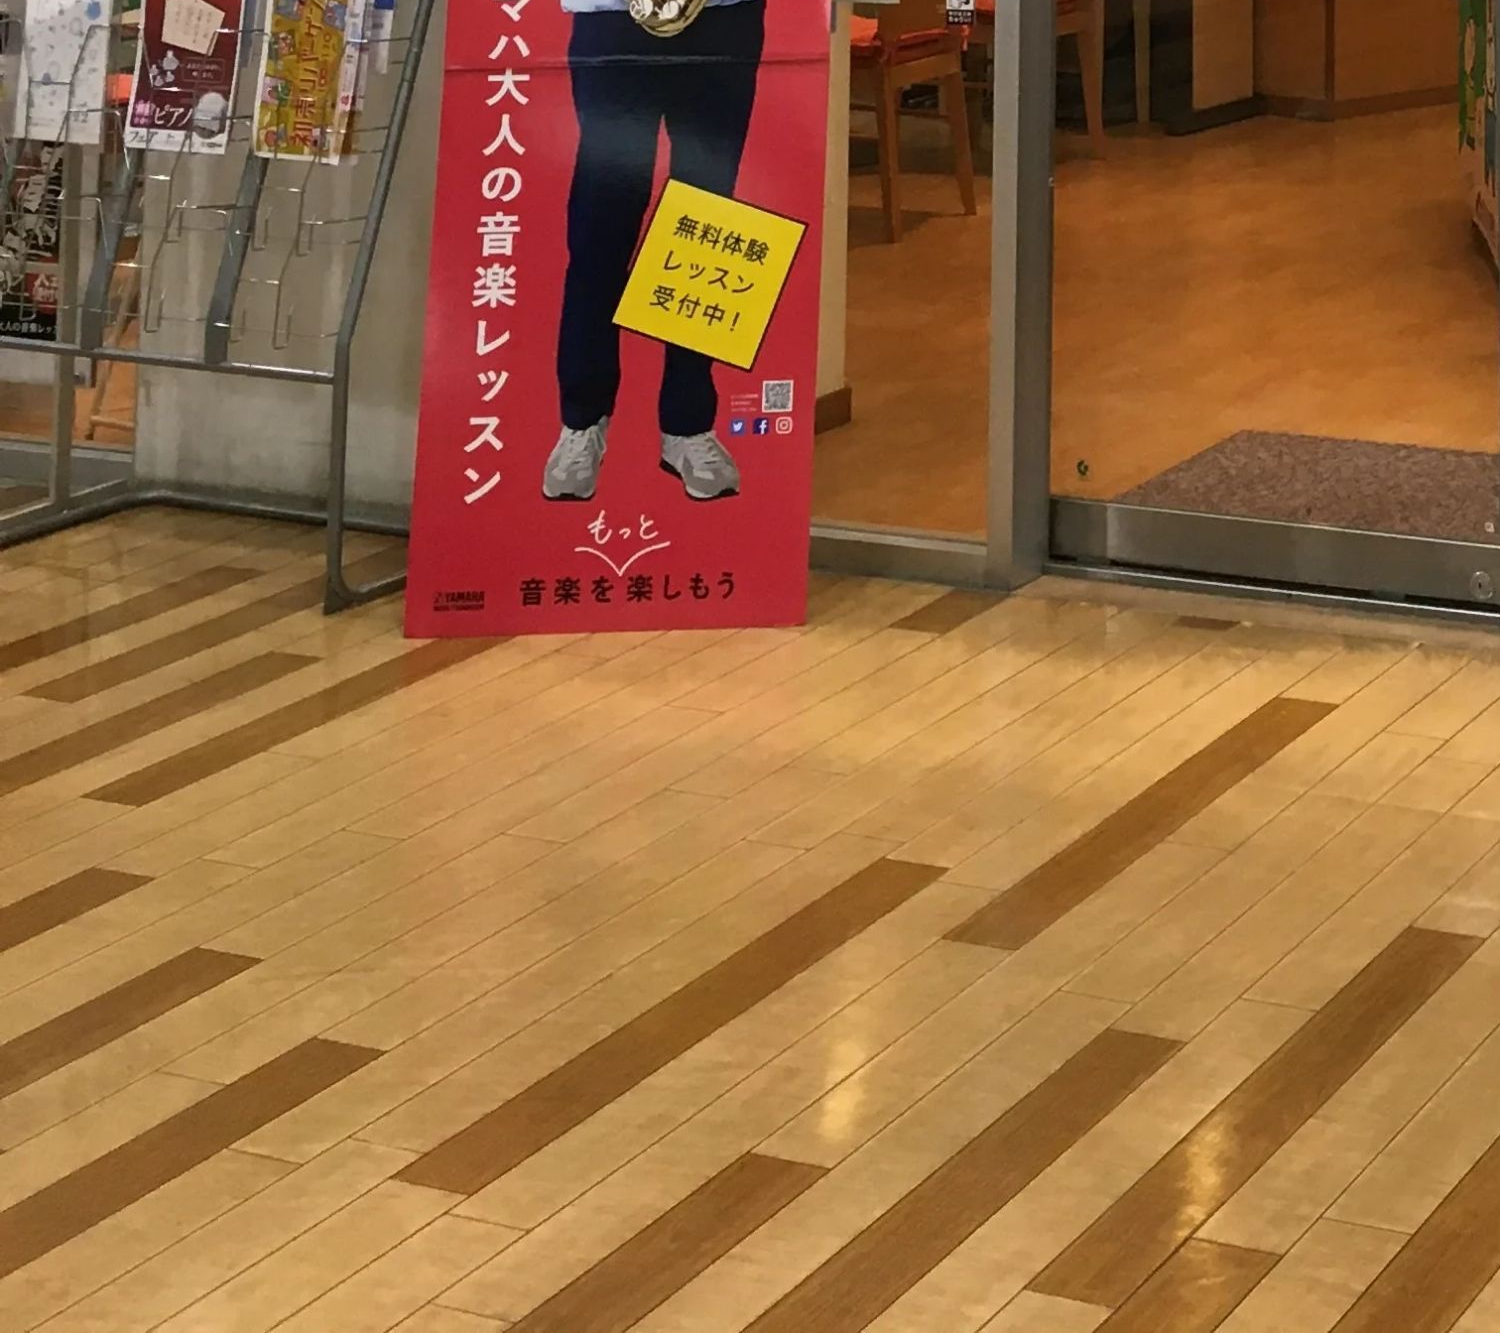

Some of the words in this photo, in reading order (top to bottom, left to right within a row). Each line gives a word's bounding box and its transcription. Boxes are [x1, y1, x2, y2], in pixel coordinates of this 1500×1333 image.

[672, 213, 771, 267] 無料体験
[663, 250, 755, 295] レッスン
[649, 284, 741, 332] 受付中!
[587, 510, 660, 545] もっと
[520, 571, 735, 607] 音楽を楽しもう
